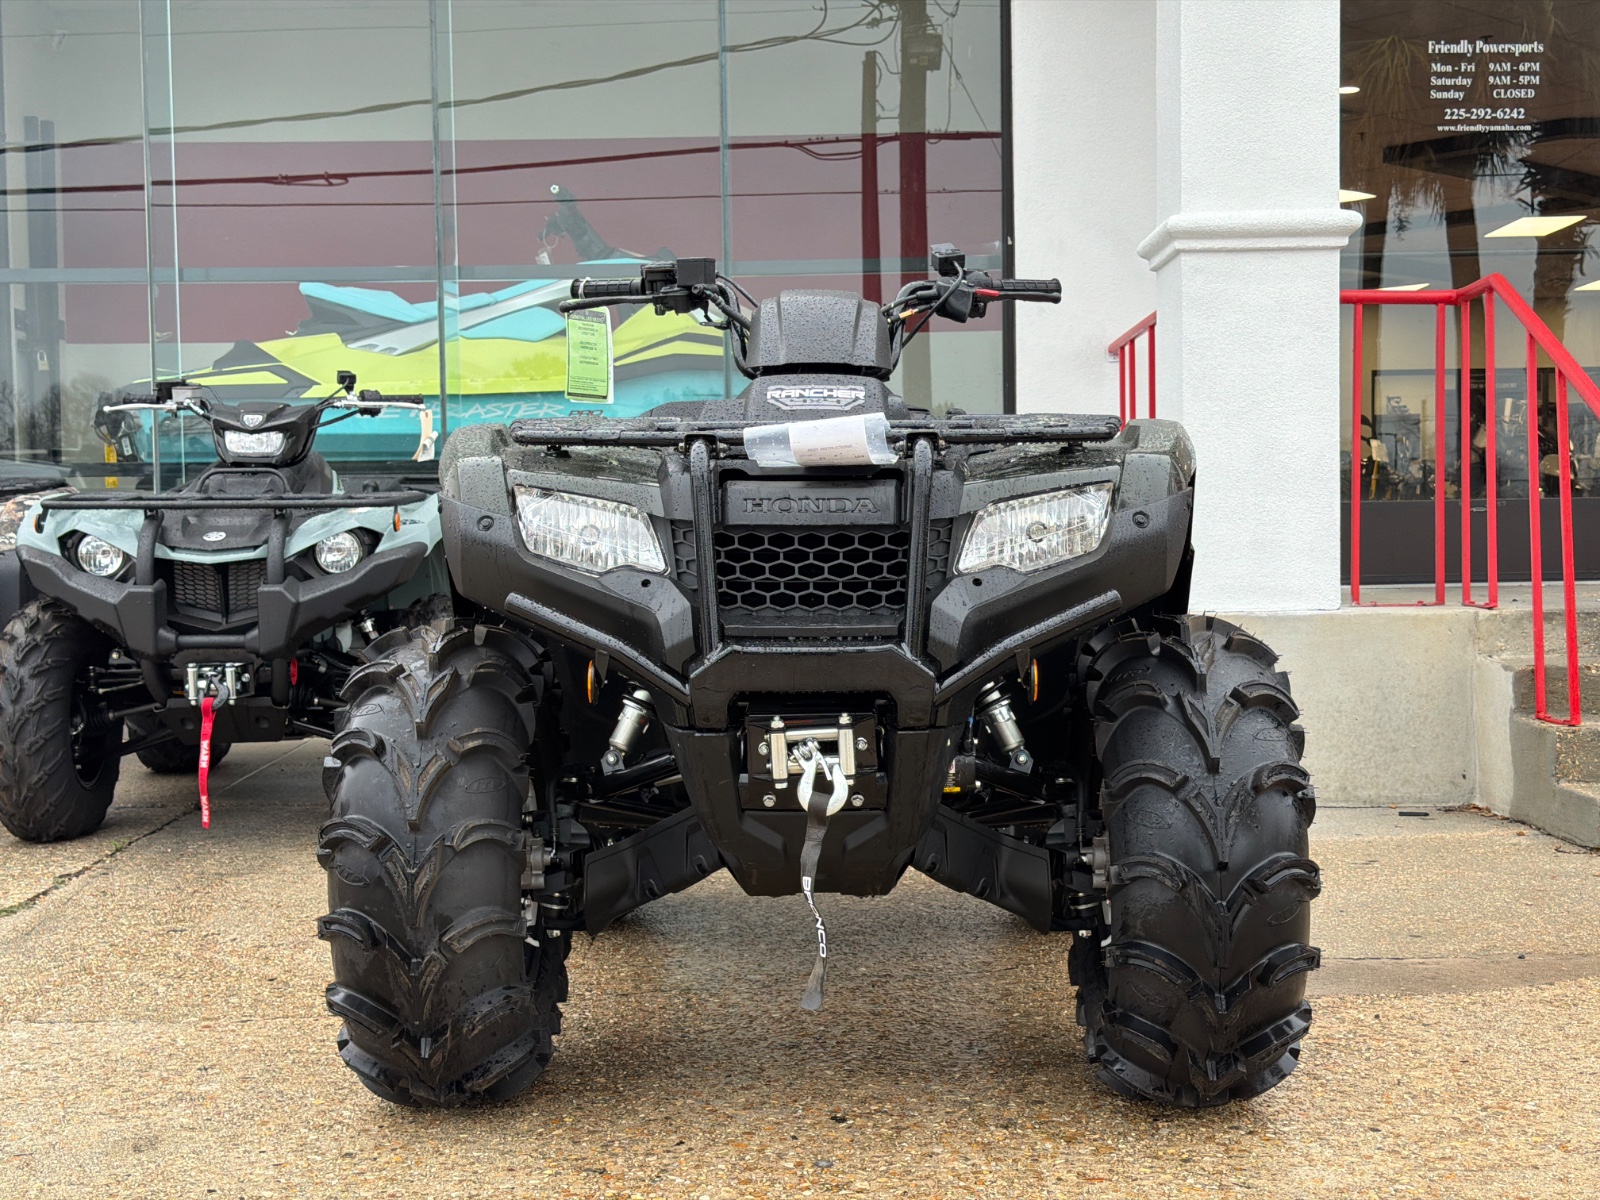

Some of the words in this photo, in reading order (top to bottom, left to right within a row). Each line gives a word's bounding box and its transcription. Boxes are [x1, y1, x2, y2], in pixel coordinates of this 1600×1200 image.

[1428, 40, 1474, 57] Friendly
[1475, 40, 1544, 57] Powersports
[1431, 63, 1452, 72] Mon
[1461, 63, 1475, 72] Fri
[1489, 63, 1511, 72] 9AM
[1519, 62, 1540, 72] 6PM
[1430, 76, 1473, 87] Saturday
[1488, 76, 1511, 85] 9AM
[1519, 76, 1540, 85] 5PM
[1430, 89, 1465, 101] Sunday
[1493, 89, 1535, 98] CLOSED
[1444, 108, 1526, 120] 225-292-6242
[1437, 124, 1532, 132] www.friendlyyamaha.com
[767, 389, 866, 399] RANCHER
[743, 497, 880, 514] HONDA
[200, 740, 209, 768] WARN
[201, 795, 209, 822] WARN
[802, 876, 827, 958] BRONCO
